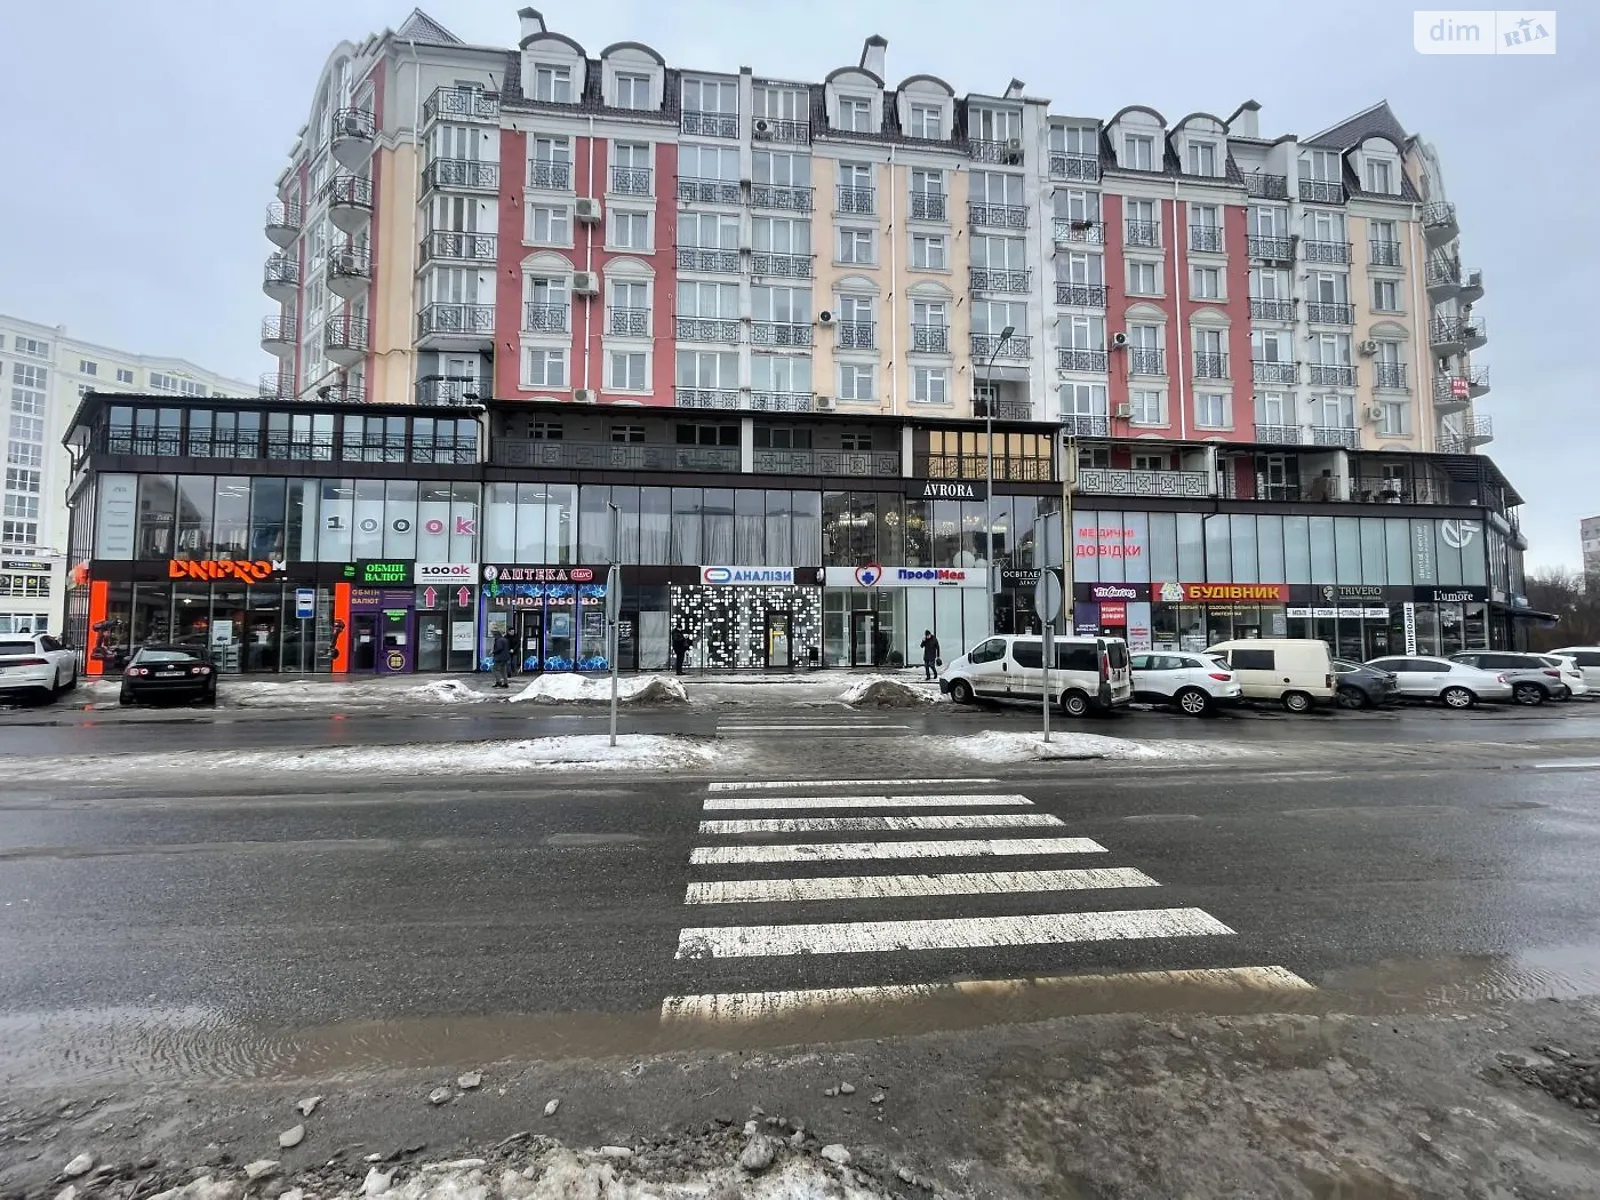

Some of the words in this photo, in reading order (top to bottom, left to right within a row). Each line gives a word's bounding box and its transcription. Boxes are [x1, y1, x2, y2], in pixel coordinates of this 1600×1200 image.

[1076, 545, 1141, 558] ДОВІДКИ
[169, 559, 272, 584] DNIPRO
[365, 573, 406, 582] ВАЛЮТ
[499, 568, 568, 581] АПТЕКА
[734, 571, 792, 581] АНАЛІЗИ
[1189, 586, 1279, 599] БУДІВНИК
[1339, 586, 1382, 595] TRIVERO
